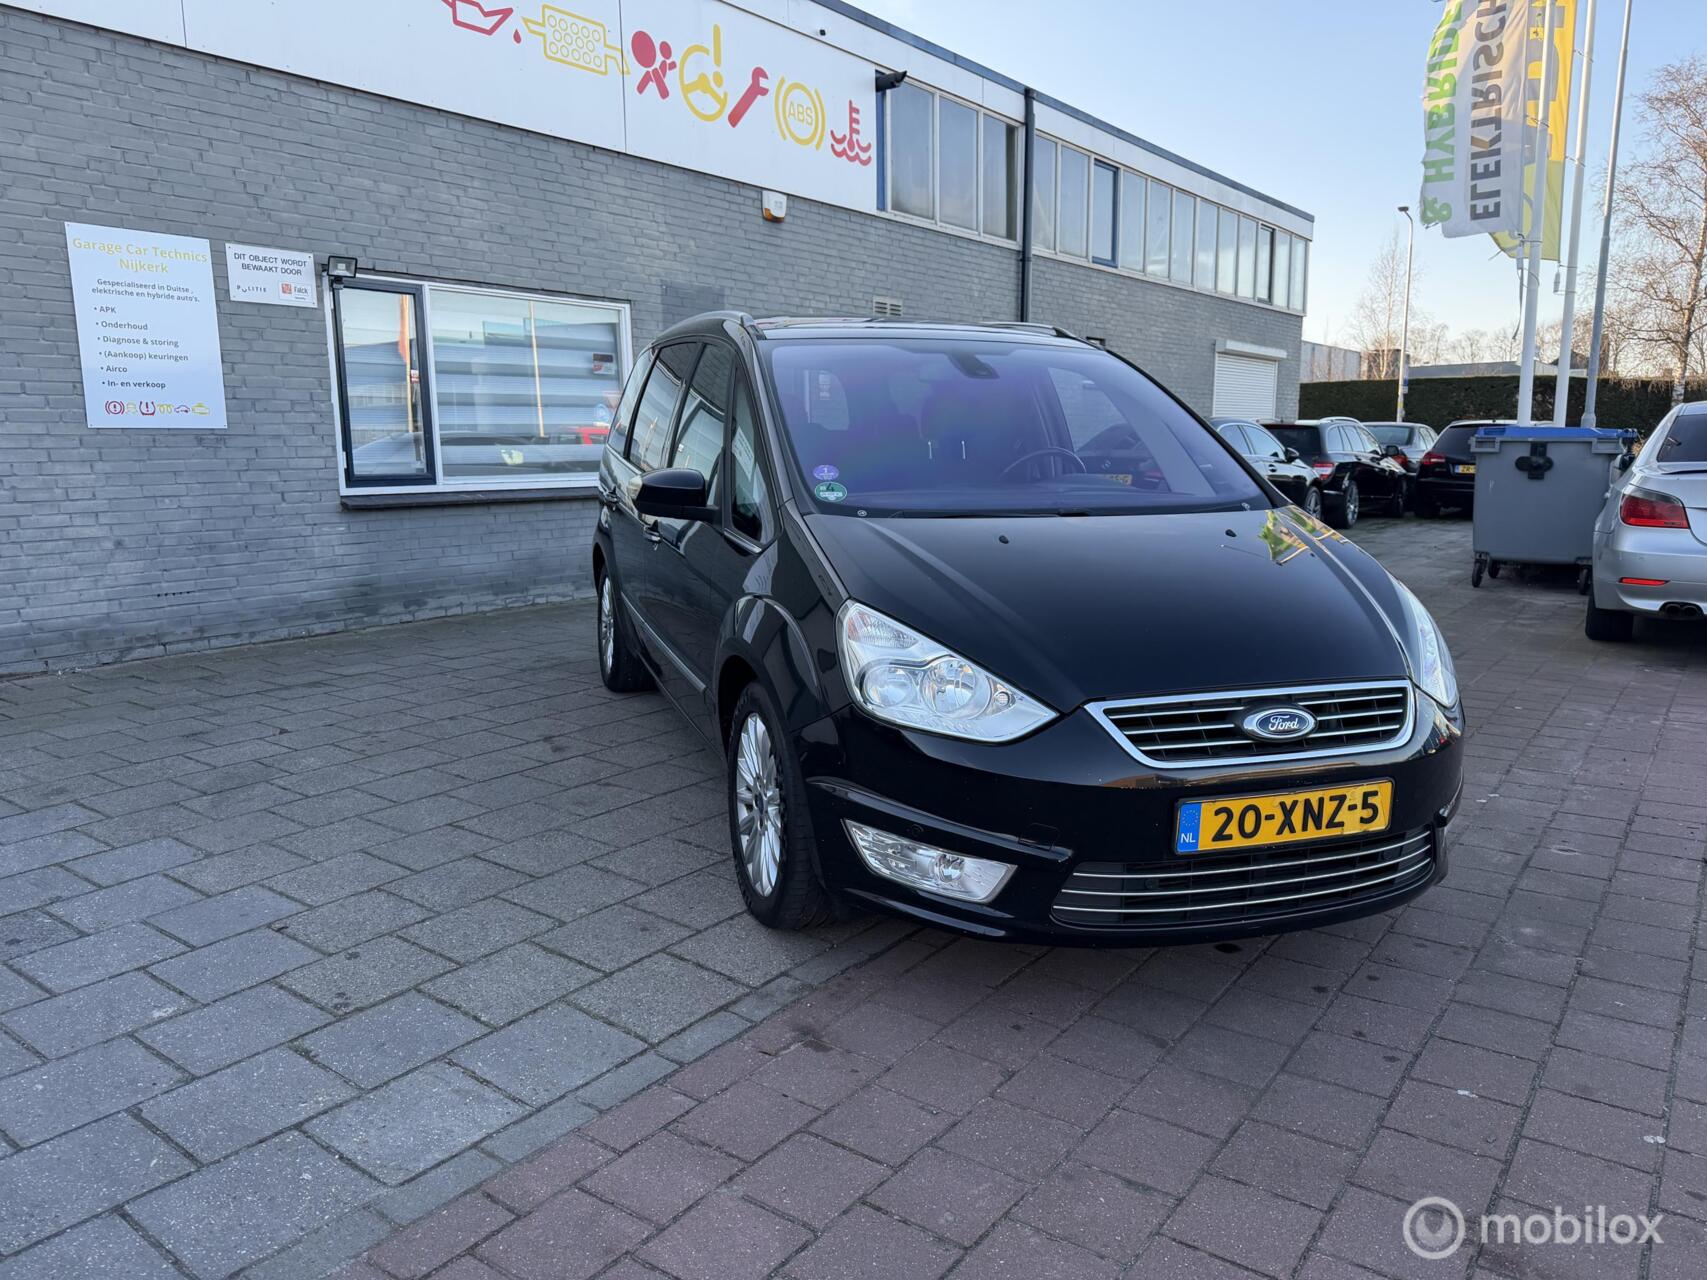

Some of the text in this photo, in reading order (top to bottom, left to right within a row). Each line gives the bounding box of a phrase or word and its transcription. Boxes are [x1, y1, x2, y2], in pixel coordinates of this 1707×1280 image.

[787, 101, 813, 126] ABS
[73, 238, 208, 262] Garage Car Technics
[119, 258, 168, 273] Nijkerk
[234, 252, 307, 267] DIT OBJECT WORDT
[242, 263, 302, 276] BEWAAKT DOOR
[97, 279, 156, 290] Gespecialiseerd
[166, 284, 190, 292] Duitse
[92, 287, 134, 297] elektrische
[147, 291, 175, 301] hybride
[99, 306, 117, 314] APK
[101, 321, 148, 330] Onderhoud
[103, 336, 141, 345] Diagnose
[151, 338, 179, 348] storing
[104, 350, 189, 362] (Aankoop) keuringen
[106, 365, 128, 373] Airco
[133, 381, 166, 389] verkoop
[1268, 714, 1299, 731] Ford
[1181, 790, 1379, 843] NL 20-XNZ-5
